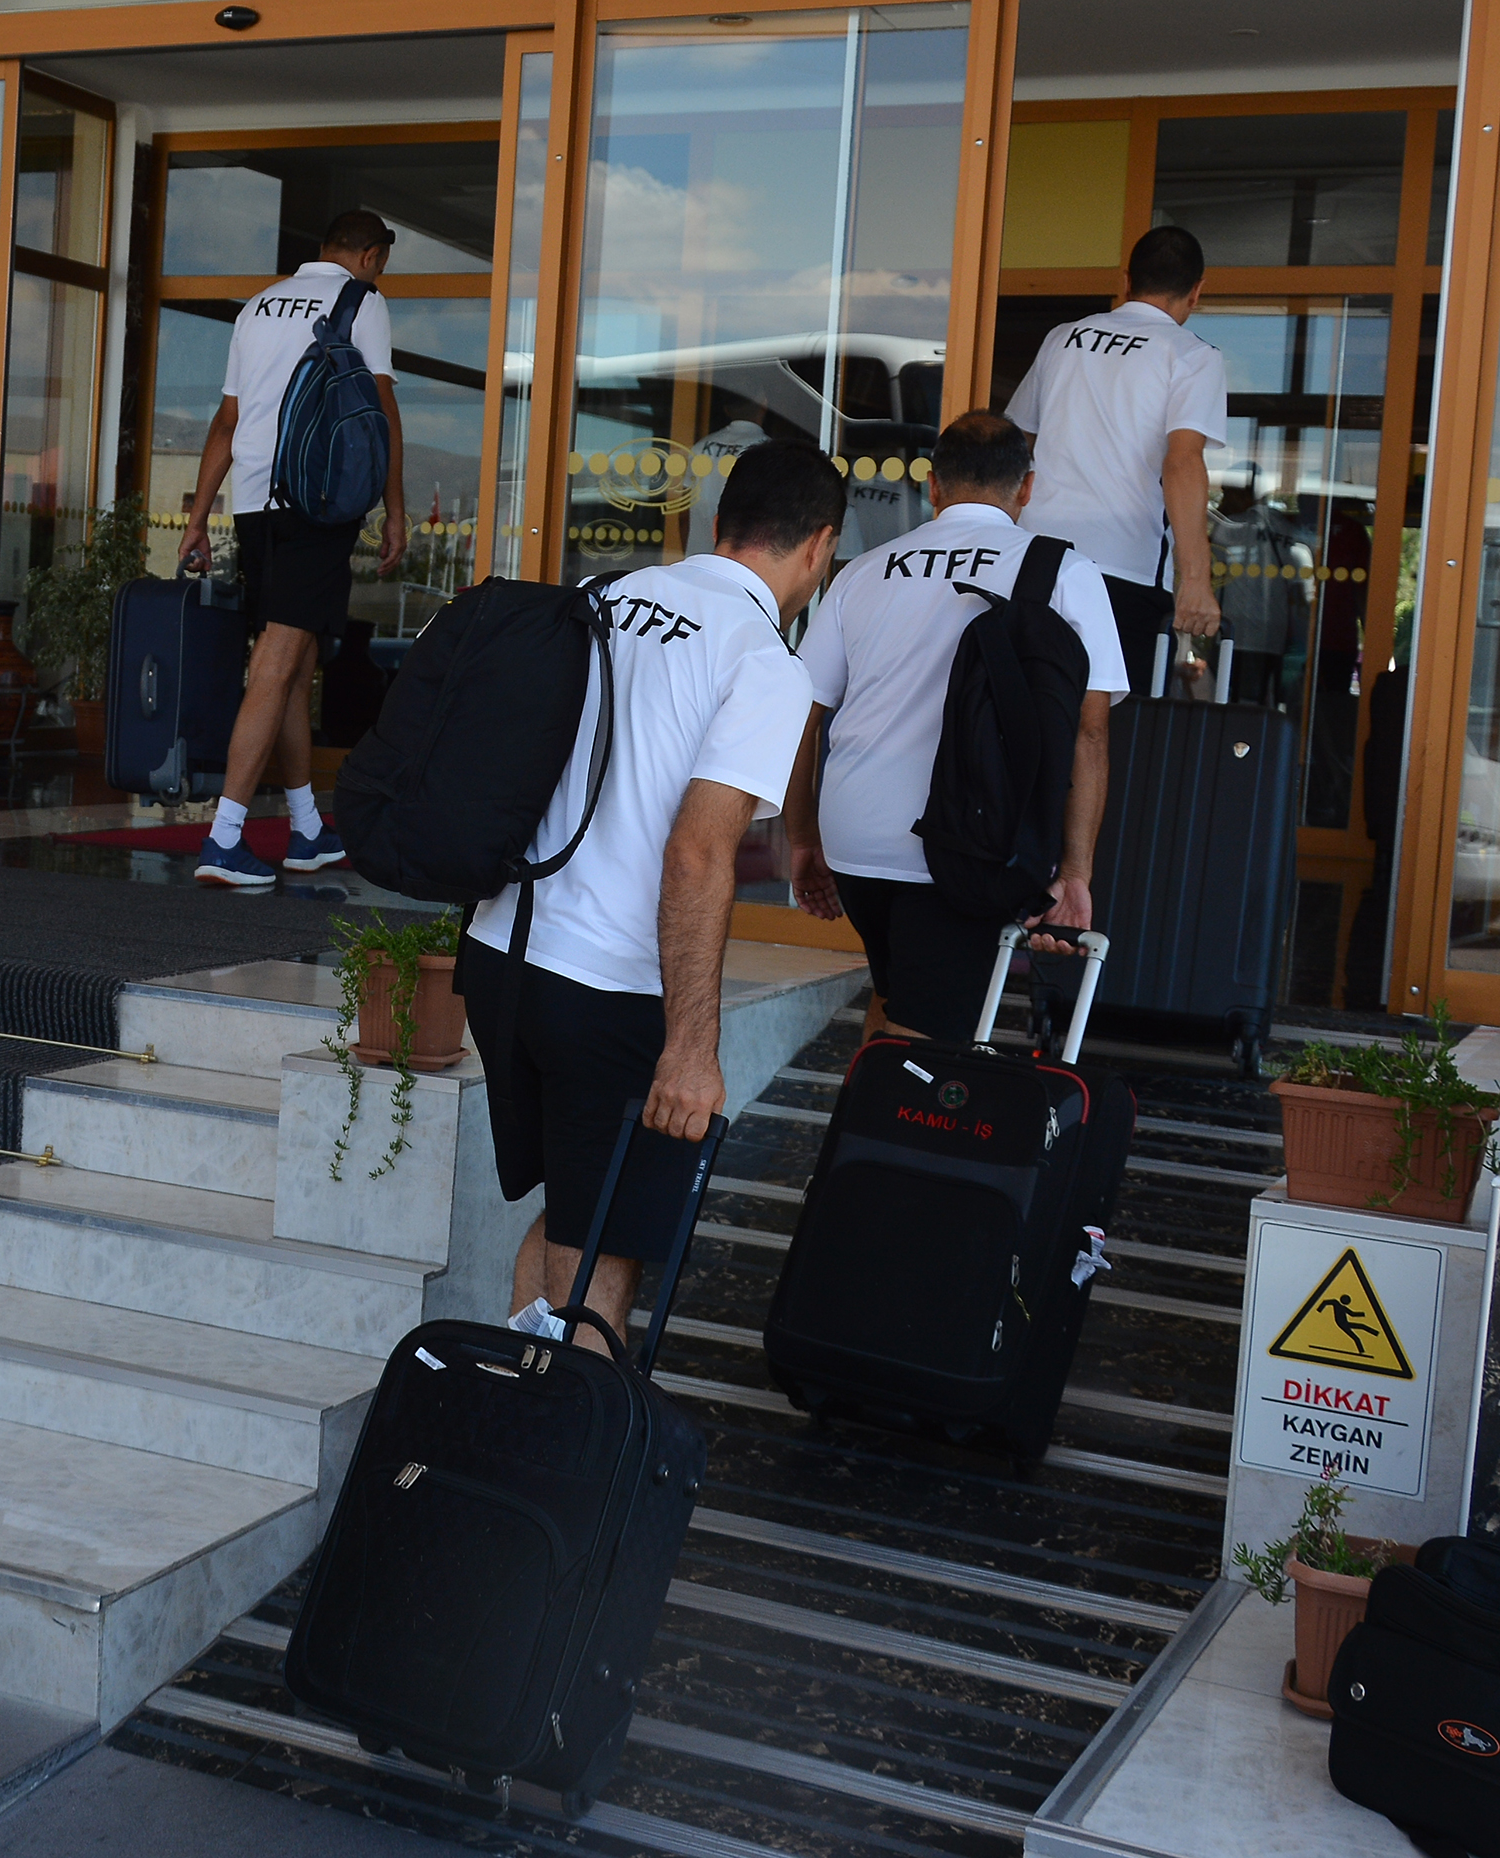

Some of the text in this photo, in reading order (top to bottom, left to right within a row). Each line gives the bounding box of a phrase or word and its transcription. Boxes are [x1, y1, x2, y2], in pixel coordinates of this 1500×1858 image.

[255, 297, 323, 319] KTFF
[1064, 327, 1150, 355] KTFF
[854, 486, 901, 505] KTFF
[883, 548, 1001, 580] KTFF
[600, 594, 702, 645] KTFF
[898, 1106, 958, 1131] KAMU
[1283, 1378, 1391, 1417] DİKKAT
[1282, 1414, 1383, 1449] KAYGAN
[1289, 1444, 1370, 1475] ZEMİN
